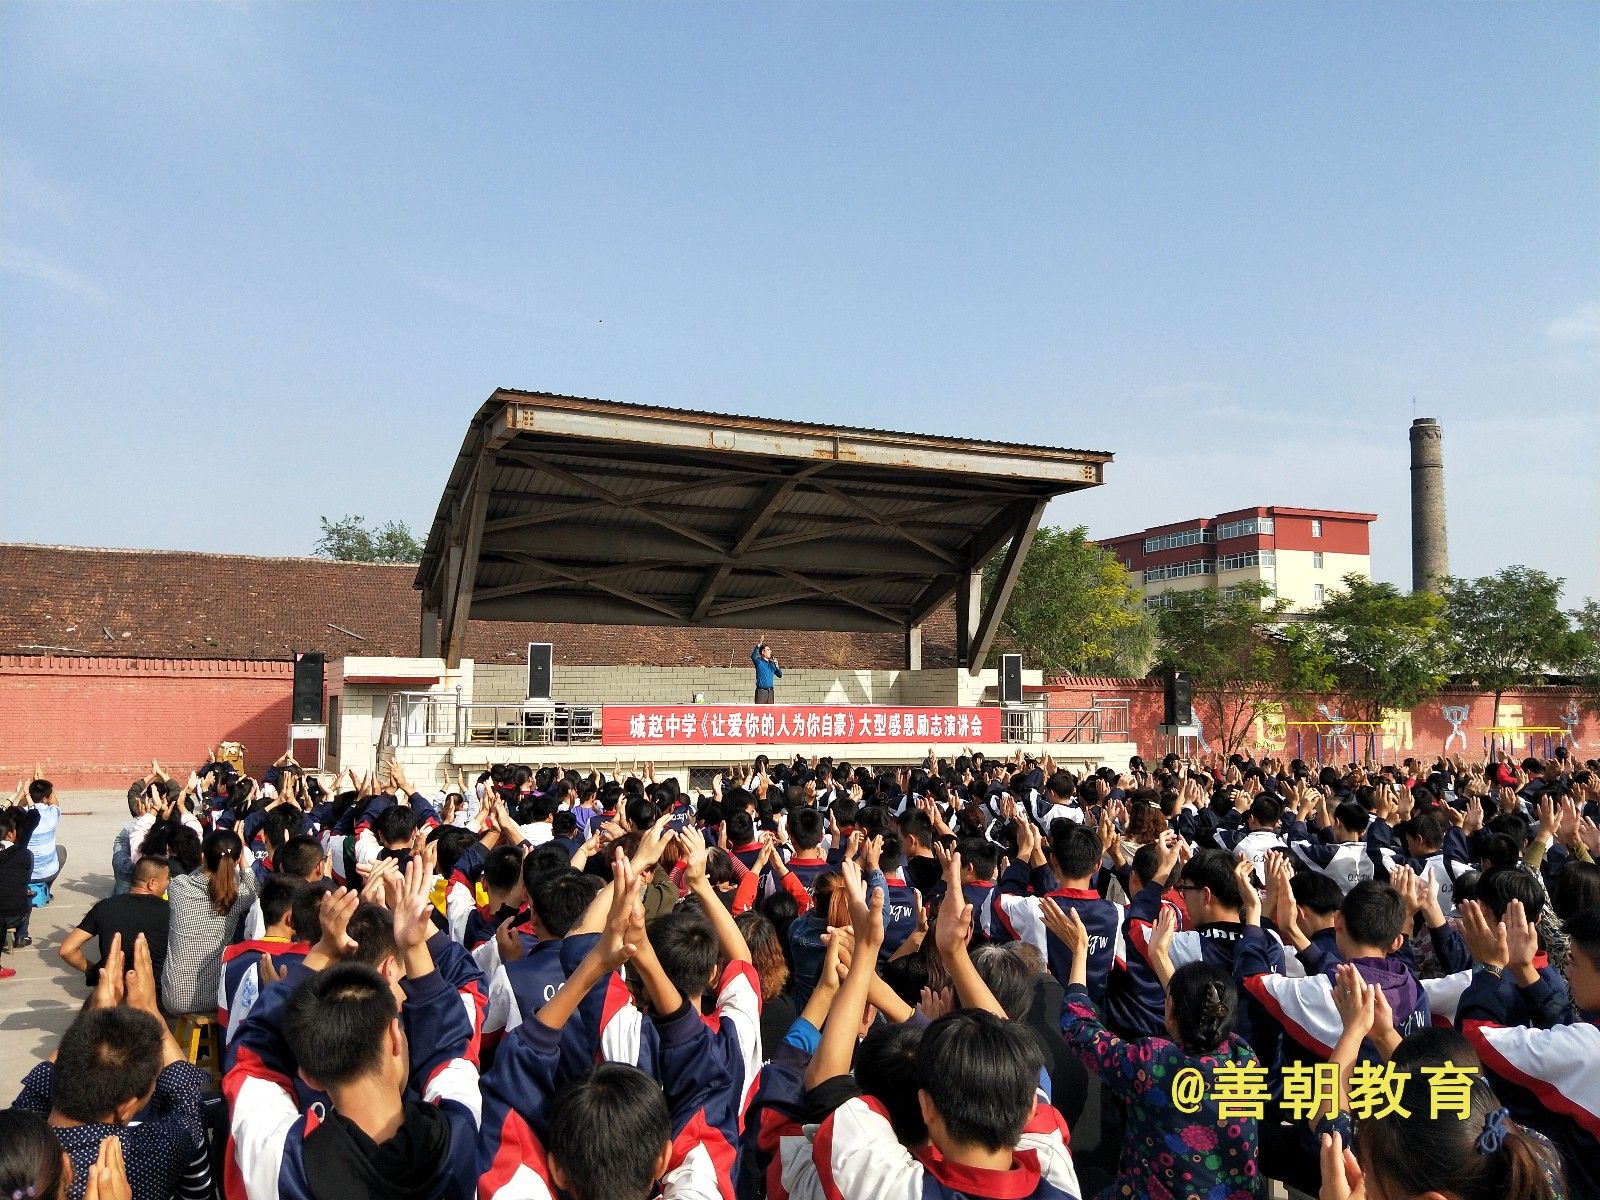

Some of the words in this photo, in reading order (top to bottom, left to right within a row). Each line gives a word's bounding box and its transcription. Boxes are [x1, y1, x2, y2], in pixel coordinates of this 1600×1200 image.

[629, 712, 983, 739] 城赵中学《让爱你的人为你自豪》大型感恩励志演讲会
